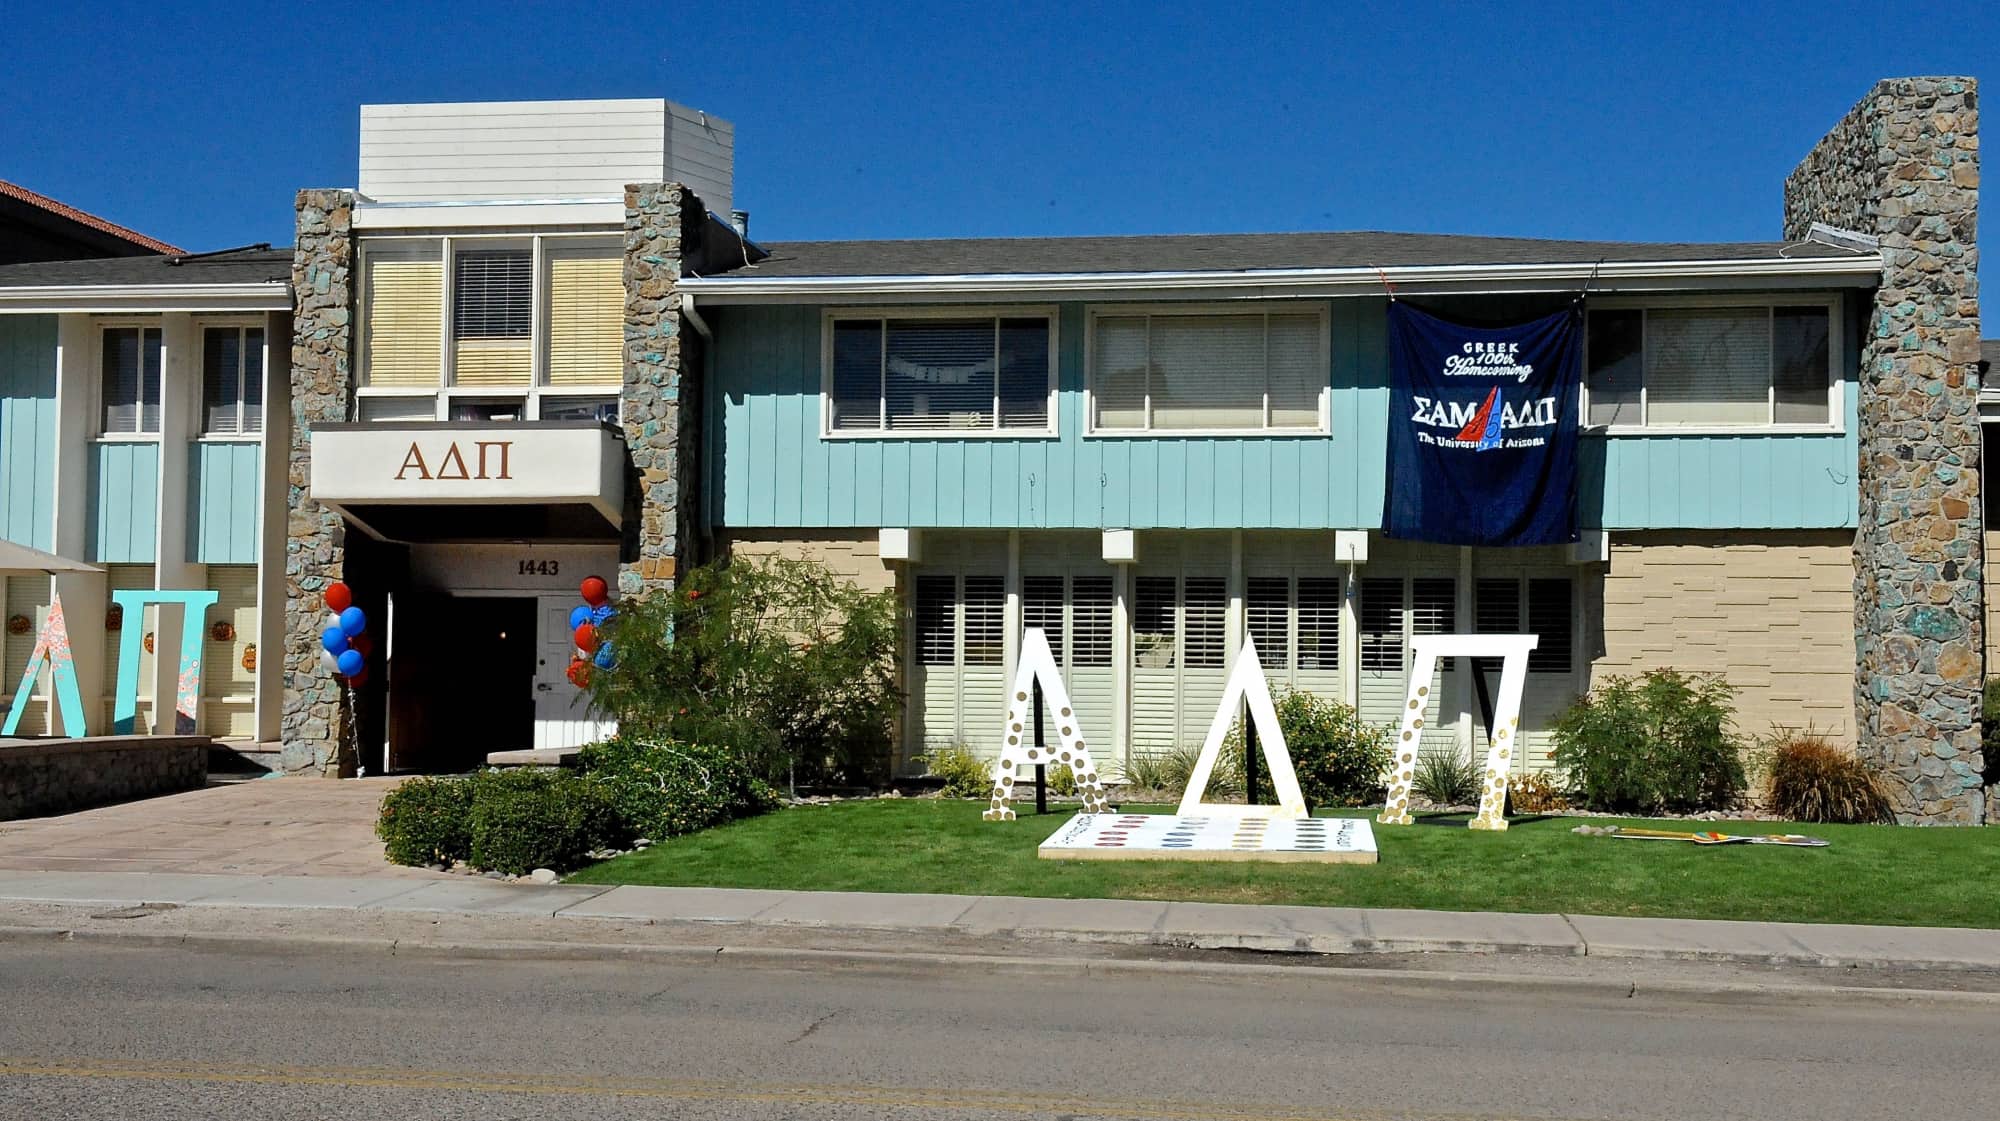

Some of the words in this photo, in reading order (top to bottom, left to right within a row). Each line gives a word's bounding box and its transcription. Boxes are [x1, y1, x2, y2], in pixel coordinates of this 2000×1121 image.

[1463, 342, 1520, 353] GREEK
[1443, 355, 1534, 383] Homecoming
[1417, 432, 1435, 445] The
[1437, 436, 1489, 449] University
[1492, 437, 1504, 449] of
[1505, 437, 1545, 448] Arizona
[394, 440, 513, 481] ΑΔΠ
[518, 559, 559, 576] 1443
